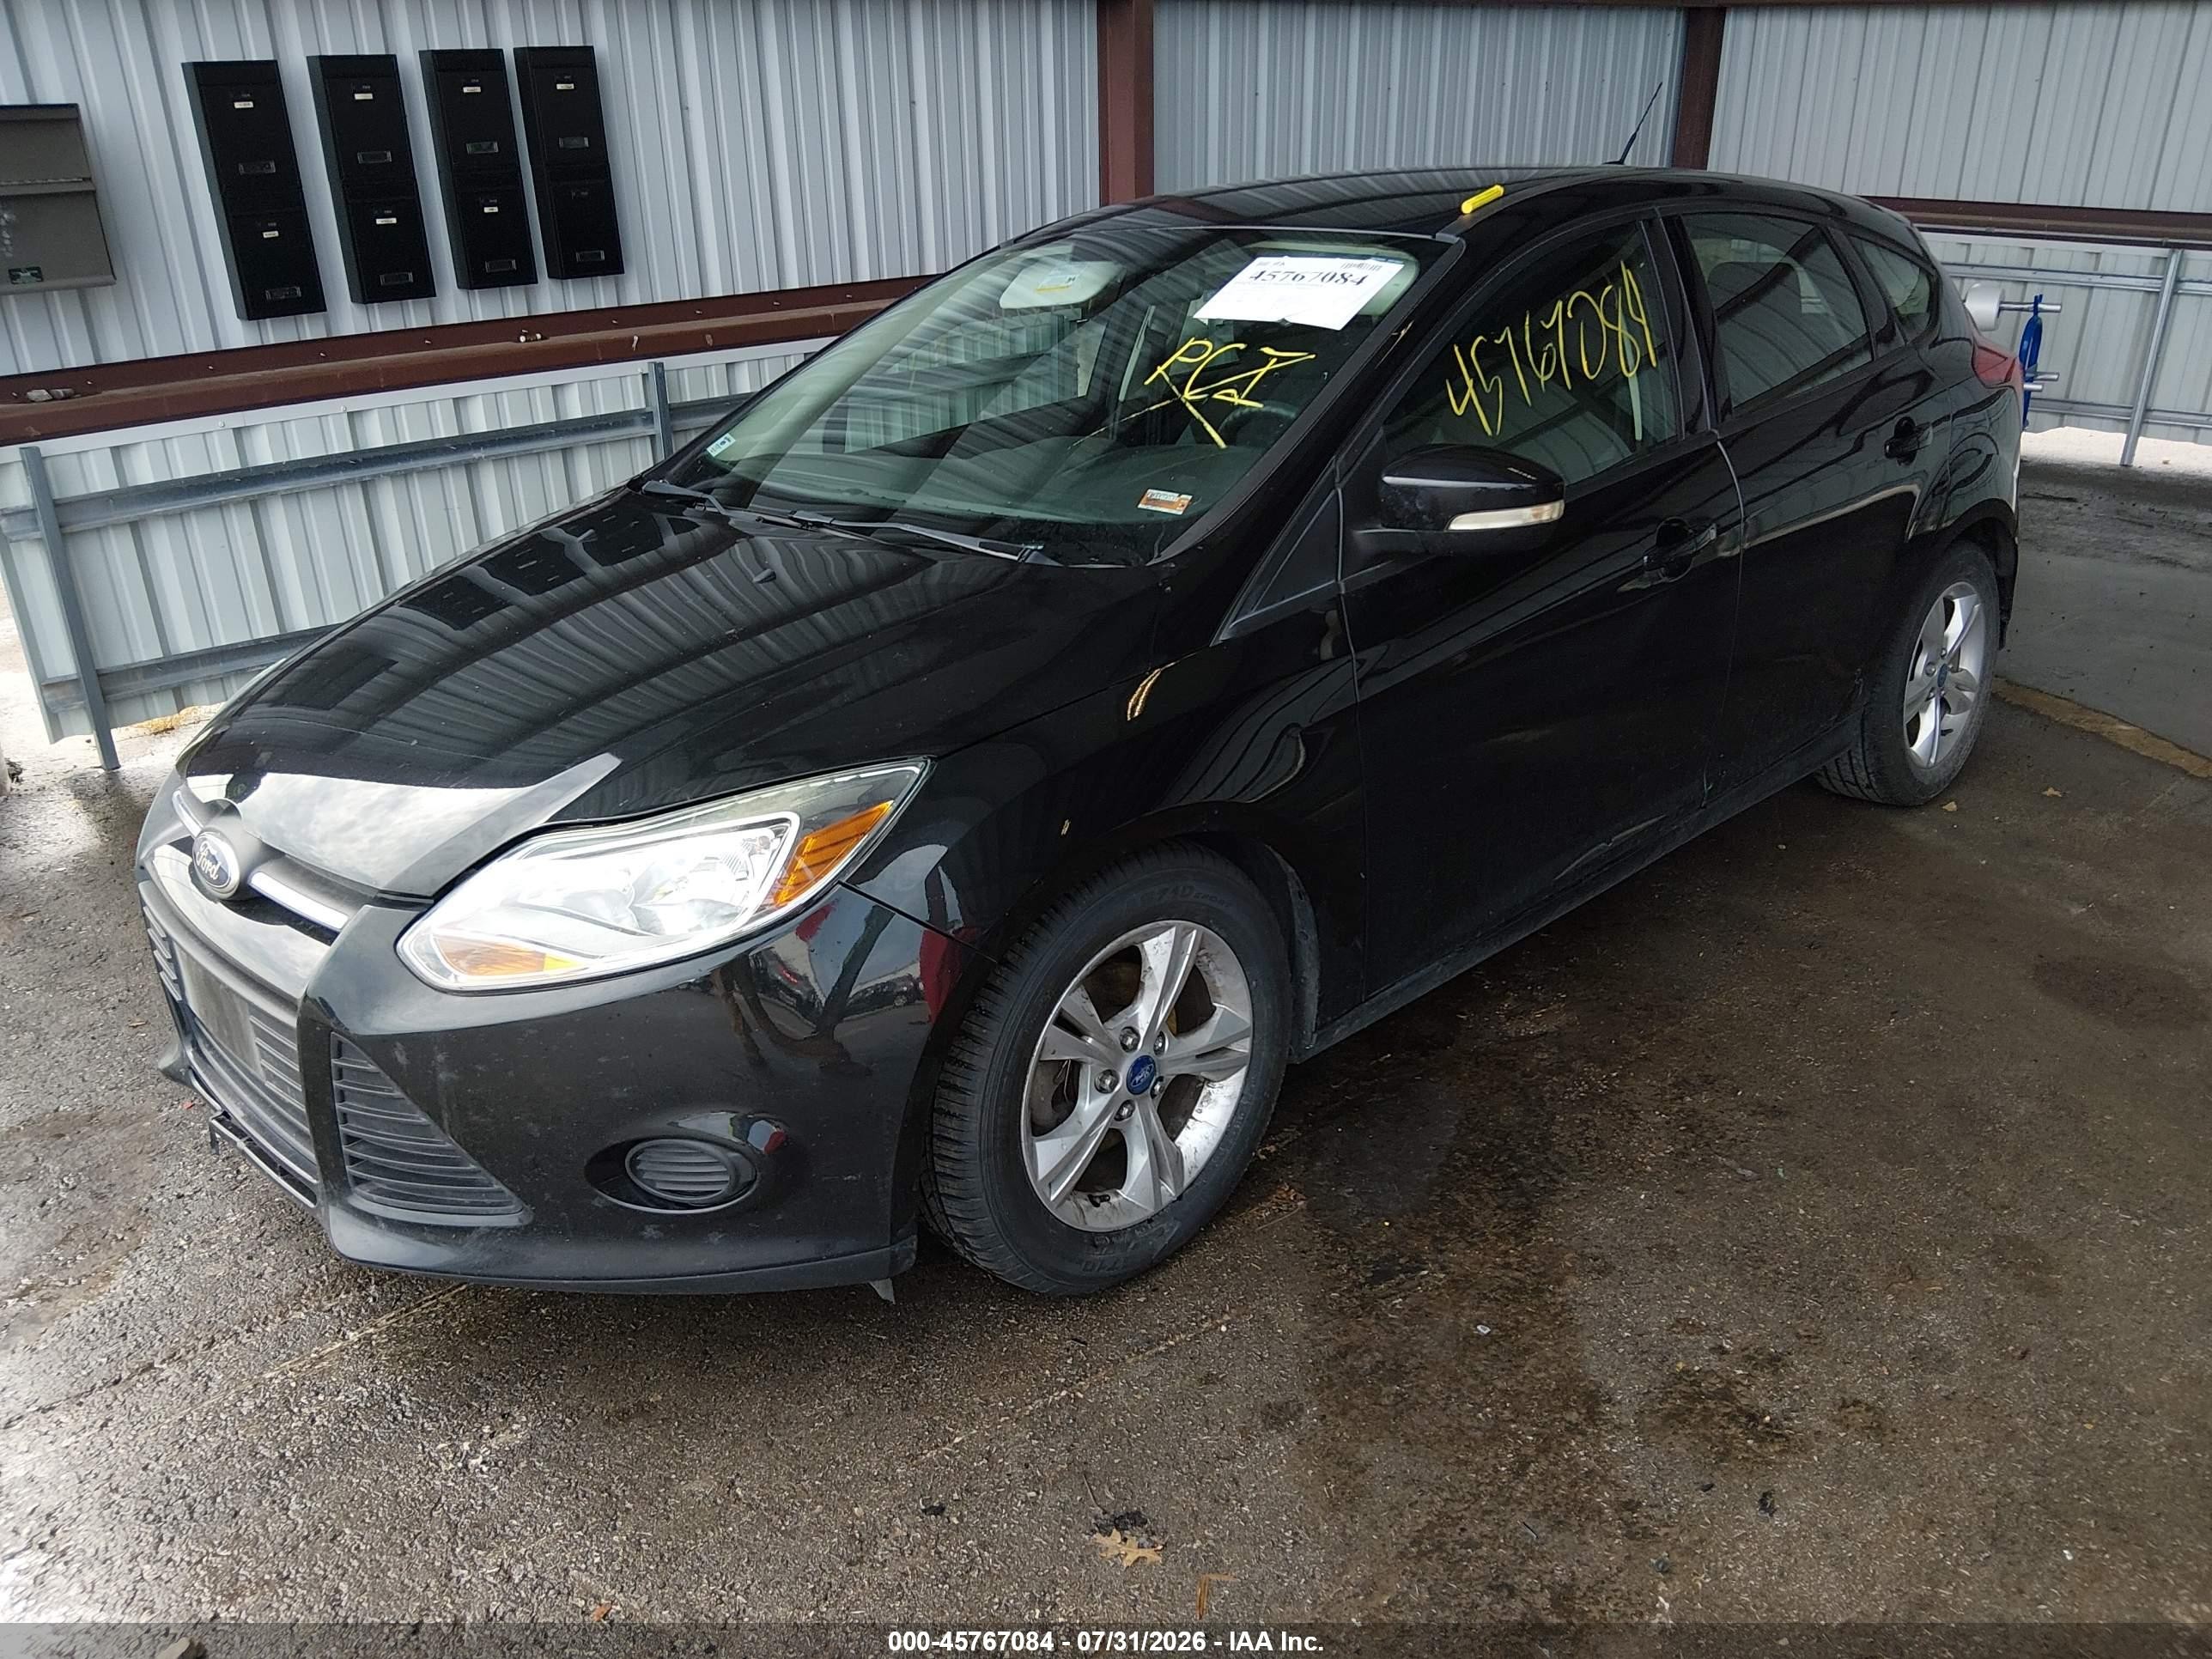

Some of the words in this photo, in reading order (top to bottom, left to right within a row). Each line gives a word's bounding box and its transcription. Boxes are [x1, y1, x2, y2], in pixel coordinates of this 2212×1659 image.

[1249, 270, 1369, 286] 45767084
[1445, 260, 1657, 437] 45767084
[196, 841, 222, 880] Ford
